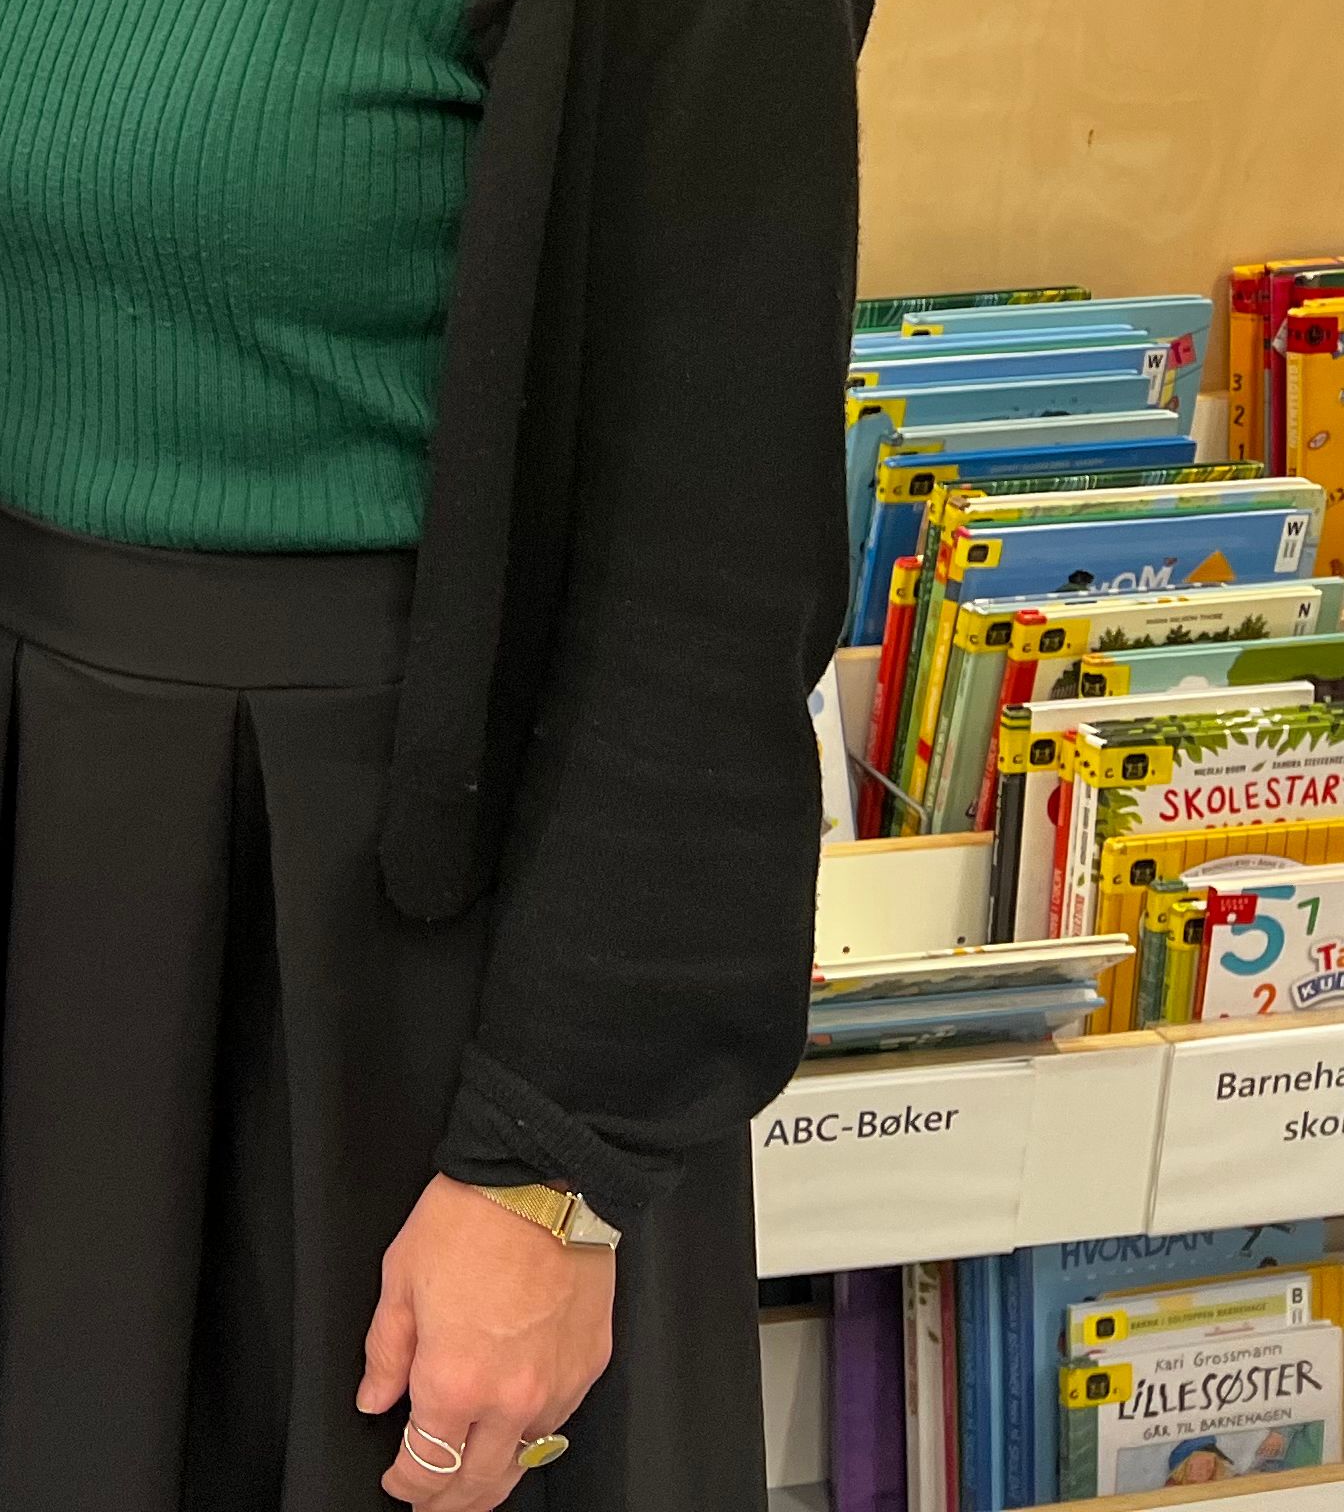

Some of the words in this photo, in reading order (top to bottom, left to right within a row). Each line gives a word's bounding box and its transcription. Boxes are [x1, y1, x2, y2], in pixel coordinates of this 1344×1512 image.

[1148, 354, 1163, 369] W
[1287, 520, 1304, 537] W
[1298, 602, 1311, 619] N
[1159, 774, 1344, 823] SKOLESTAR
[763, 1105, 959, 1148] ABC-Bøker
[1283, 1110, 1344, 1141] sko
[1292, 1287, 1303, 1305] B
[1155, 1356, 1184, 1373] Kari
[1193, 1342, 1283, 1368] Grossmann
[1177, 1422, 1194, 1434] TIL
[1200, 1408, 1292, 1433] BARNEHAGEN
